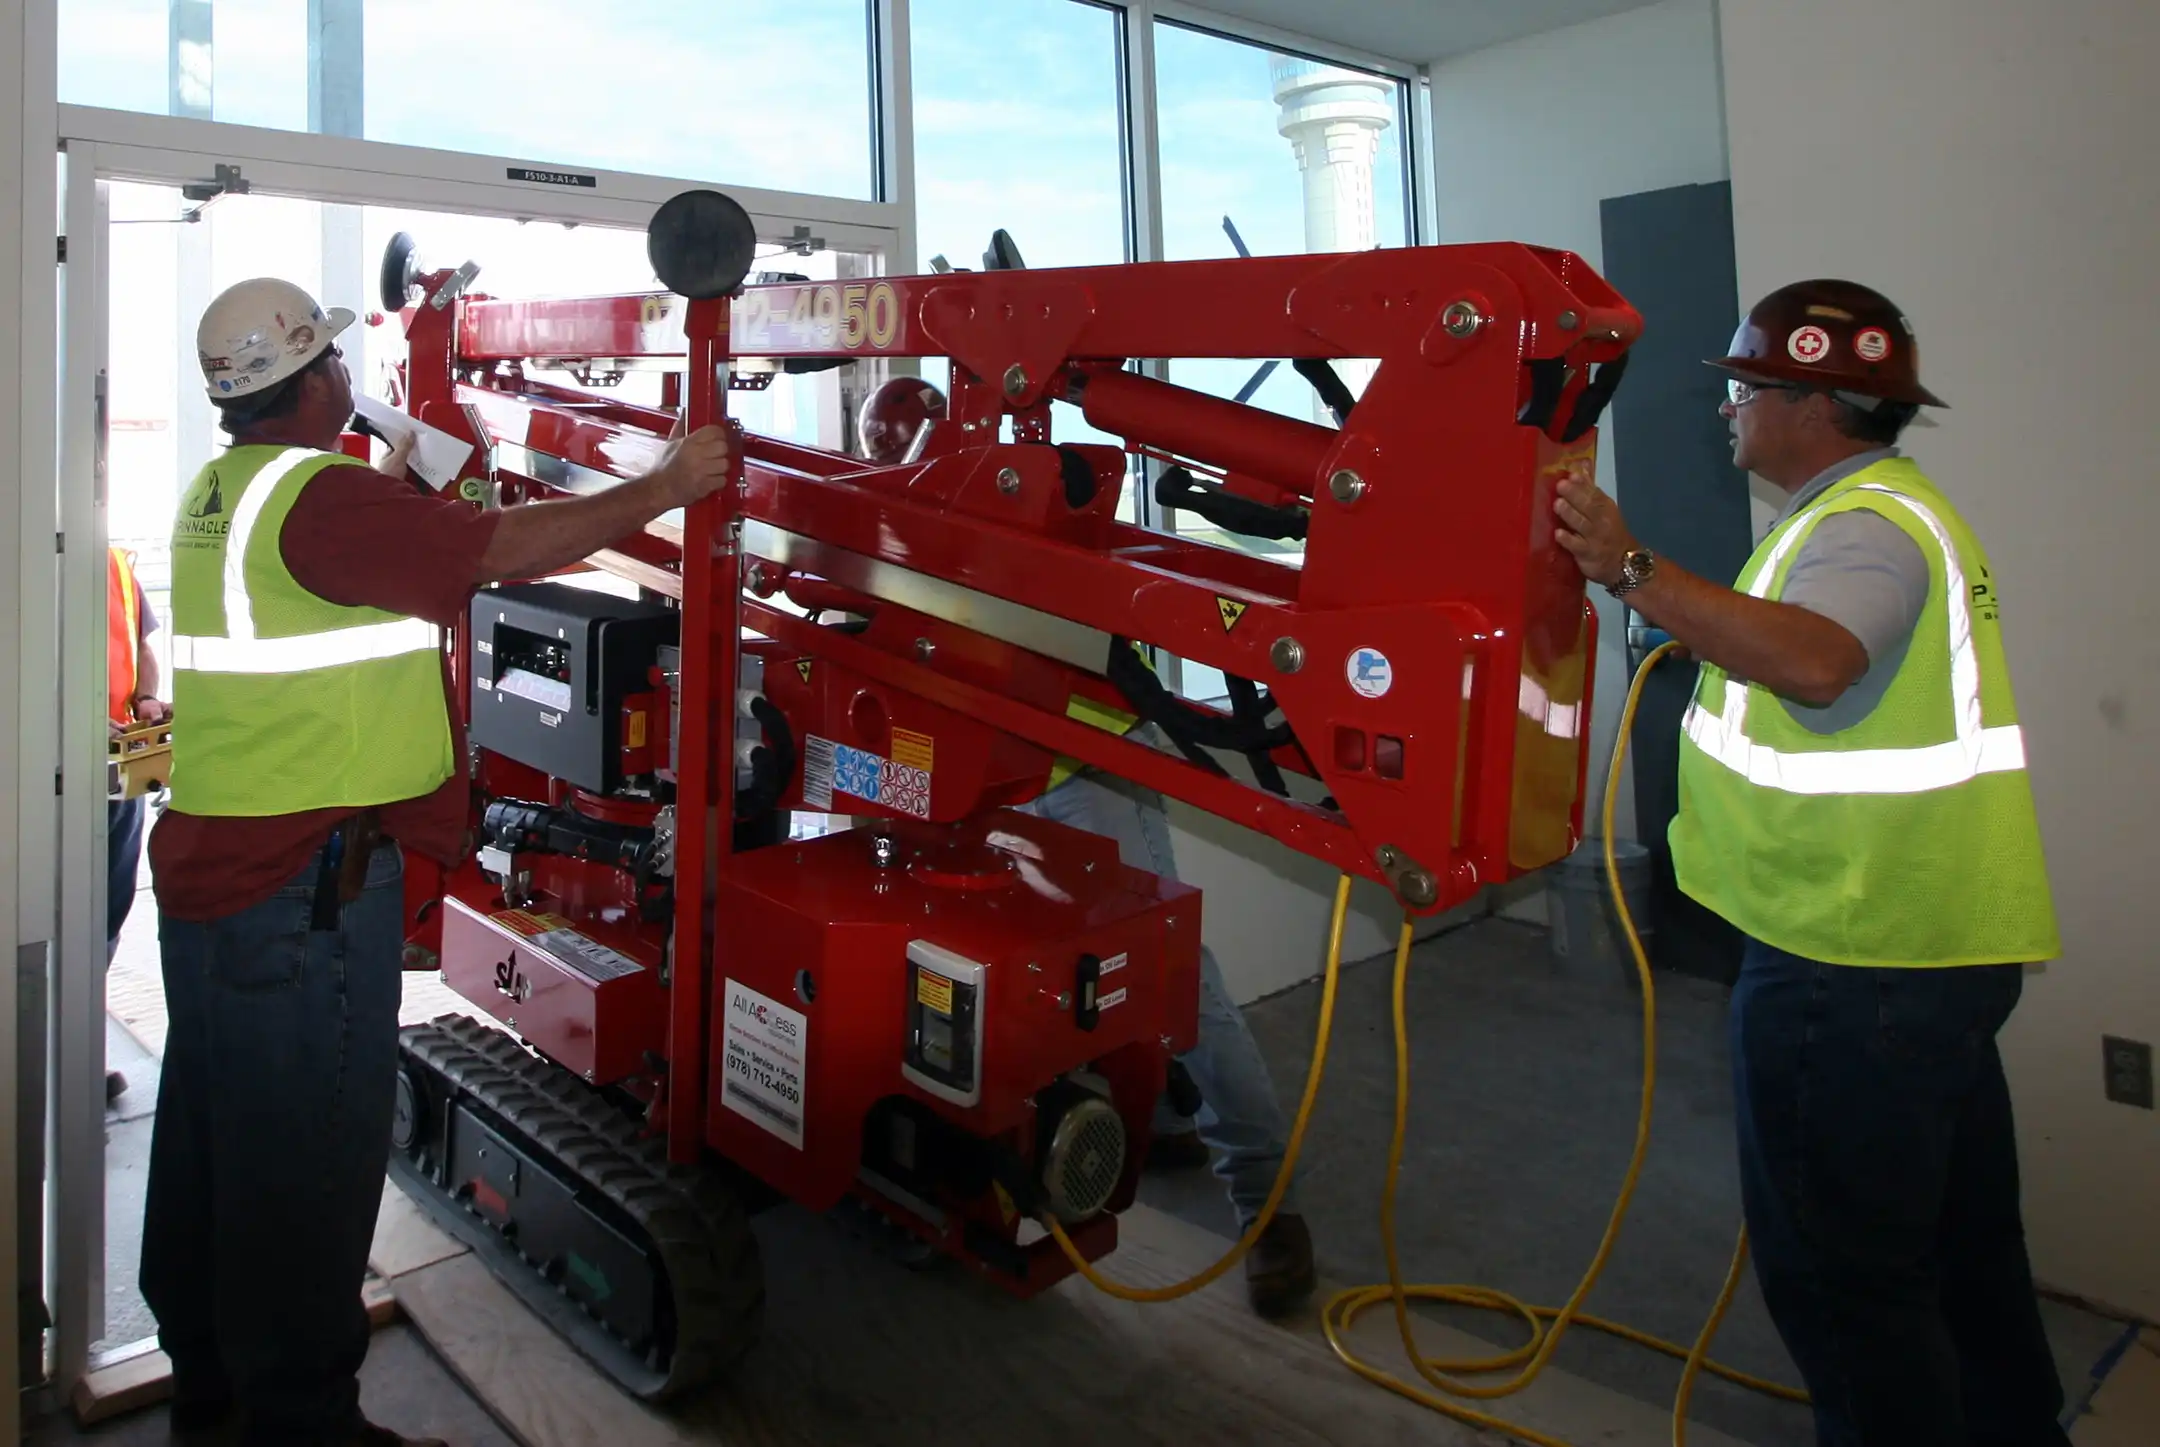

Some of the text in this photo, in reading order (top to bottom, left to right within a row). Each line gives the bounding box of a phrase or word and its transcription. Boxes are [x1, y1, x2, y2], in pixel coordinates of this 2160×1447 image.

[733, 994, 747, 1014] All
[752, 1052, 775, 1072] Service
[727, 1053, 750, 1080] (978)
[754, 1067, 799, 1104] 712-4950
